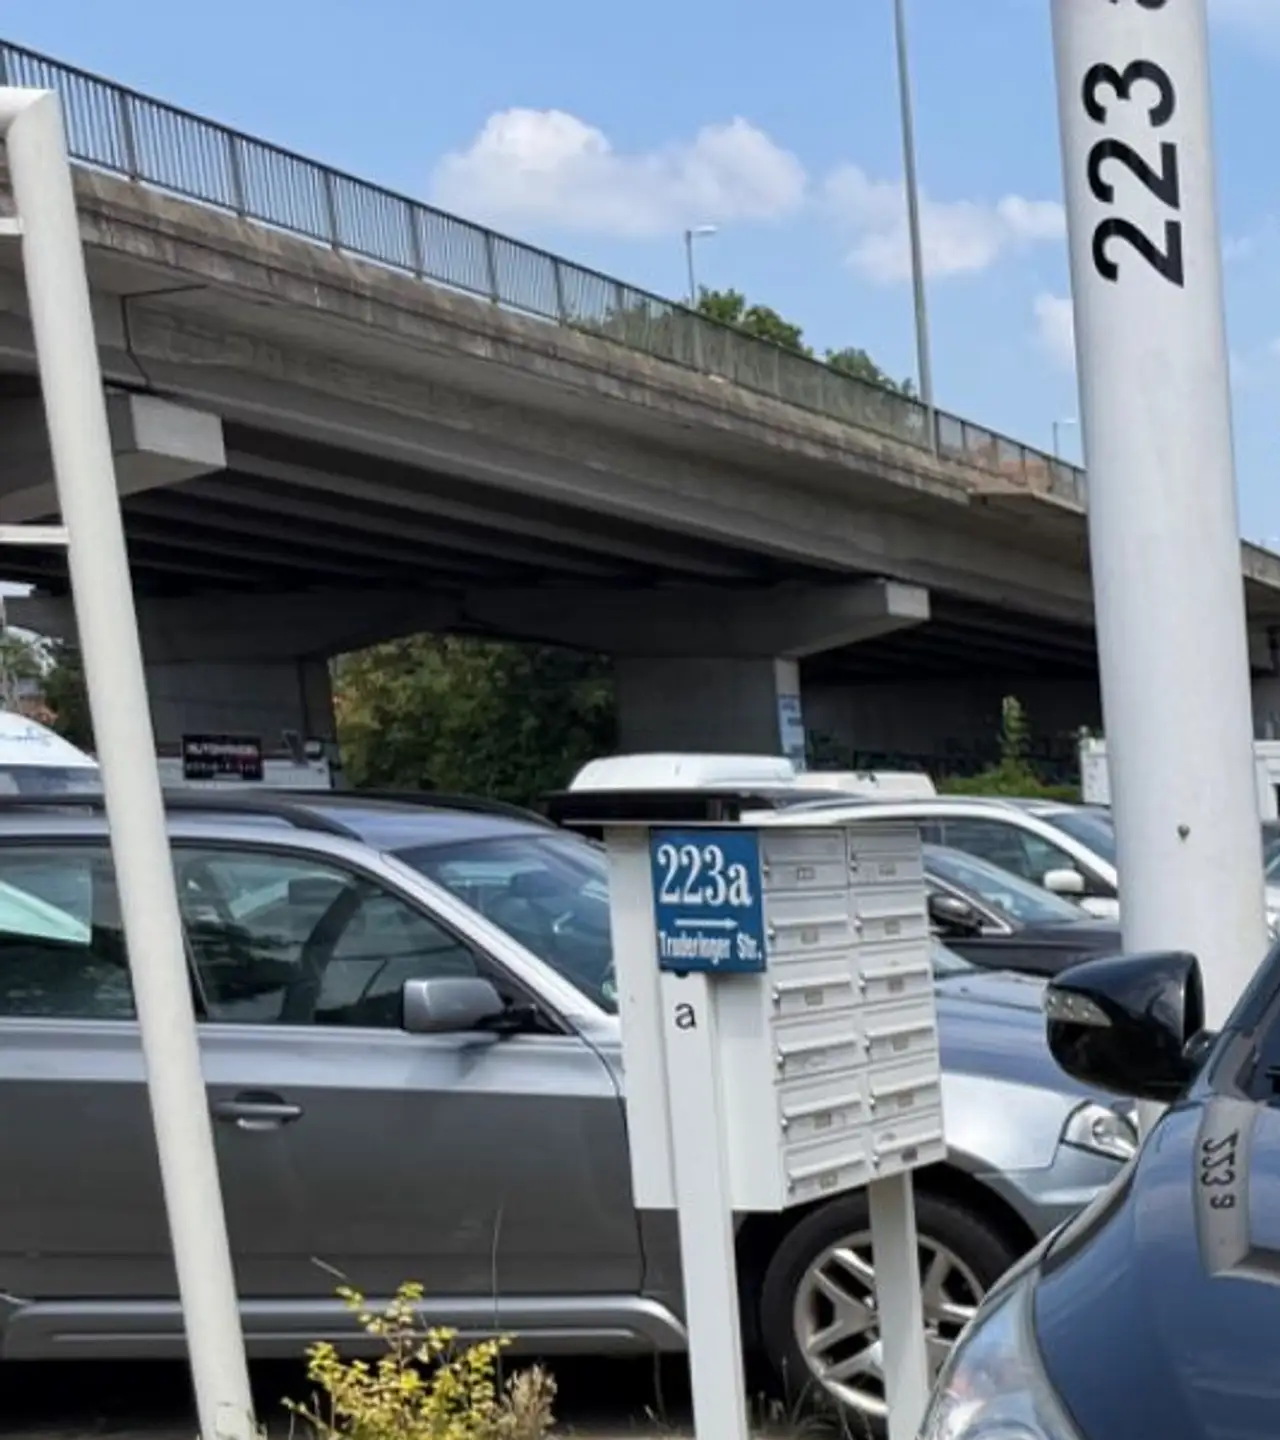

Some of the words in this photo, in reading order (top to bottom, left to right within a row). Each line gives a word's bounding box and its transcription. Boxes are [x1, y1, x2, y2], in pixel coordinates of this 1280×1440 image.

[1082, 59, 1184, 288] 223
[657, 844, 753, 907] 223a
[736, 931, 763, 960] Str.
[674, 1002, 697, 1030] a
